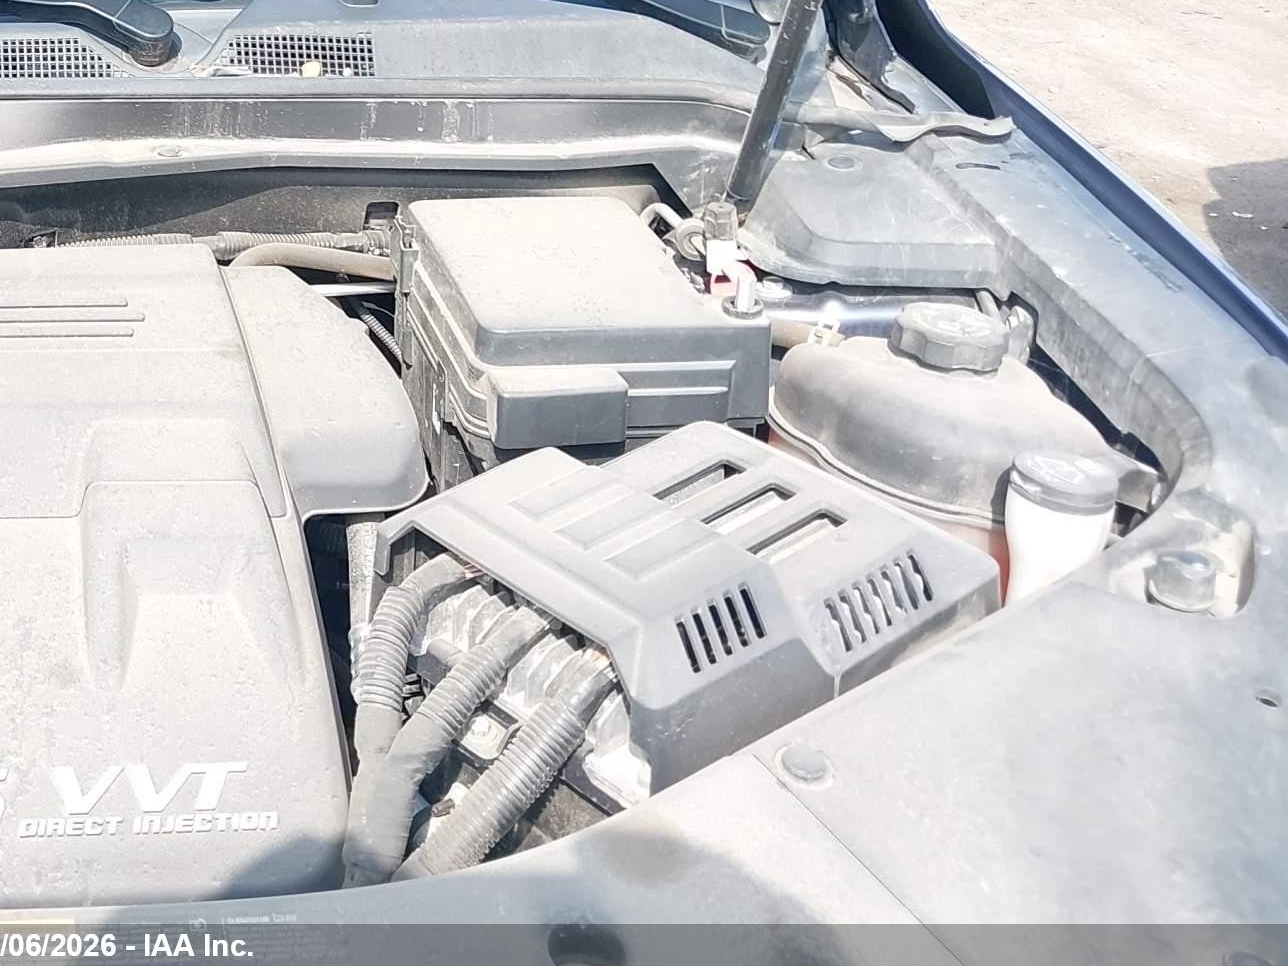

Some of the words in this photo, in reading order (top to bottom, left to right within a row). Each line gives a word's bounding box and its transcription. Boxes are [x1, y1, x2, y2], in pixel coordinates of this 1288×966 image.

[50, 761, 249, 815] VVT
[18, 816, 124, 839] DIRECT
[132, 810, 280, 835] INJECTION
